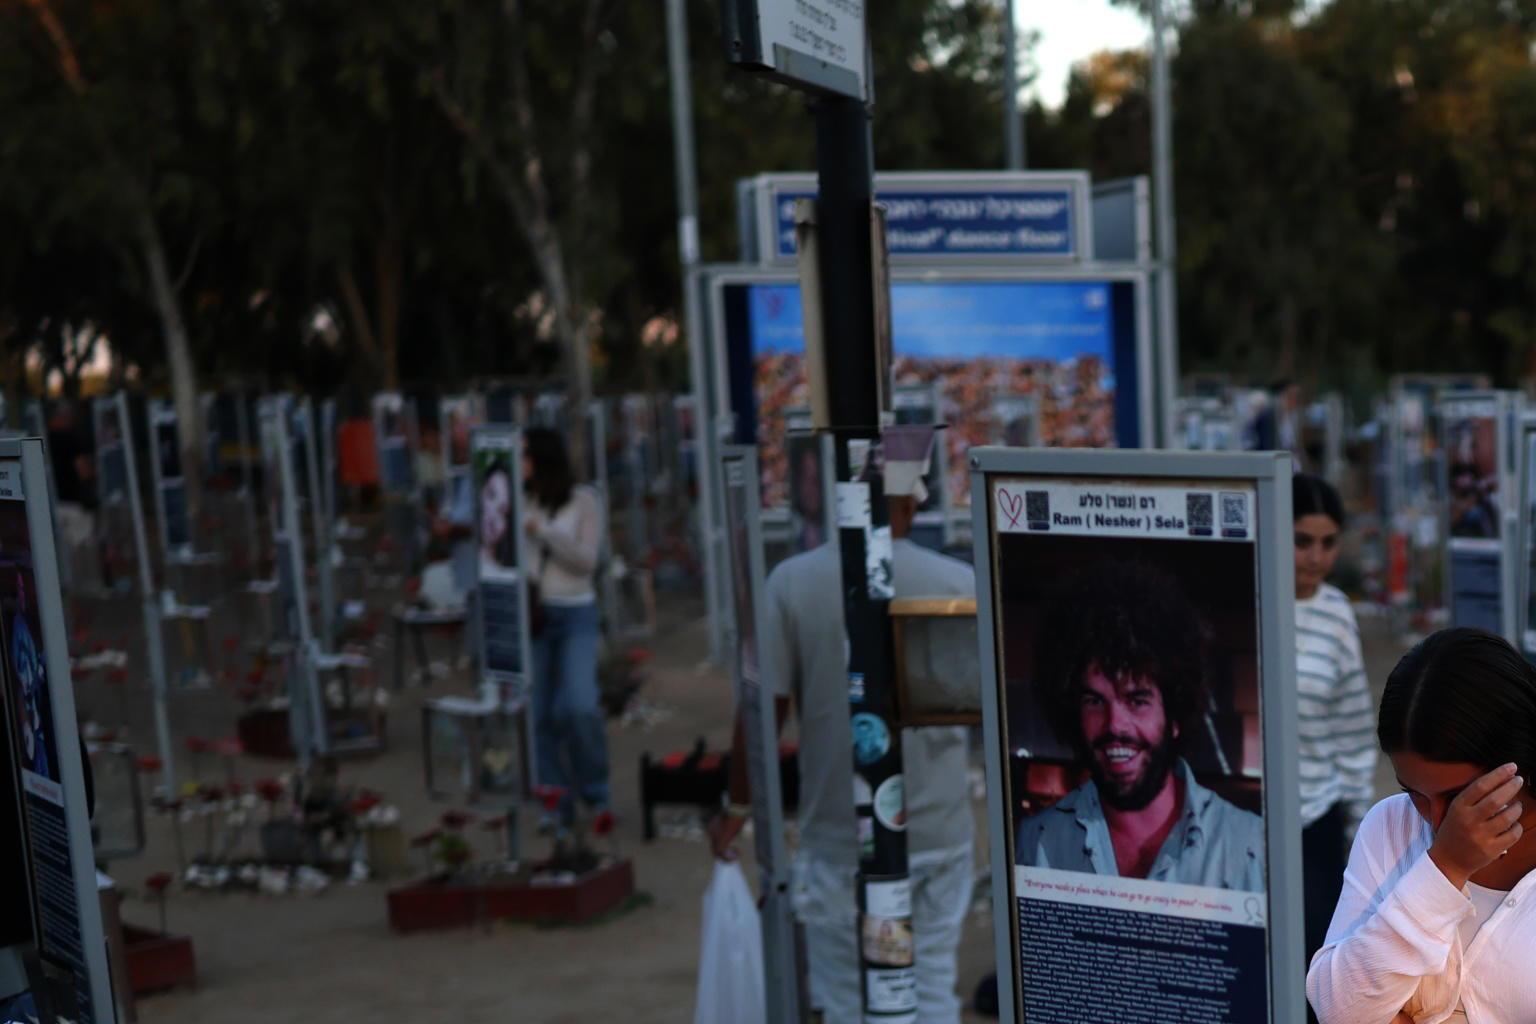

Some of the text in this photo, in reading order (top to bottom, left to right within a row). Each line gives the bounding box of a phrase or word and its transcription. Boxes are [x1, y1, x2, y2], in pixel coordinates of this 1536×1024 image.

[1079, 492, 1103, 508] סלע
[1140, 494, 1156, 508] רם
[1053, 513, 1082, 526] Ram
[1095, 514, 1141, 528] Nesher
[1155, 515, 1184, 529] Sela
